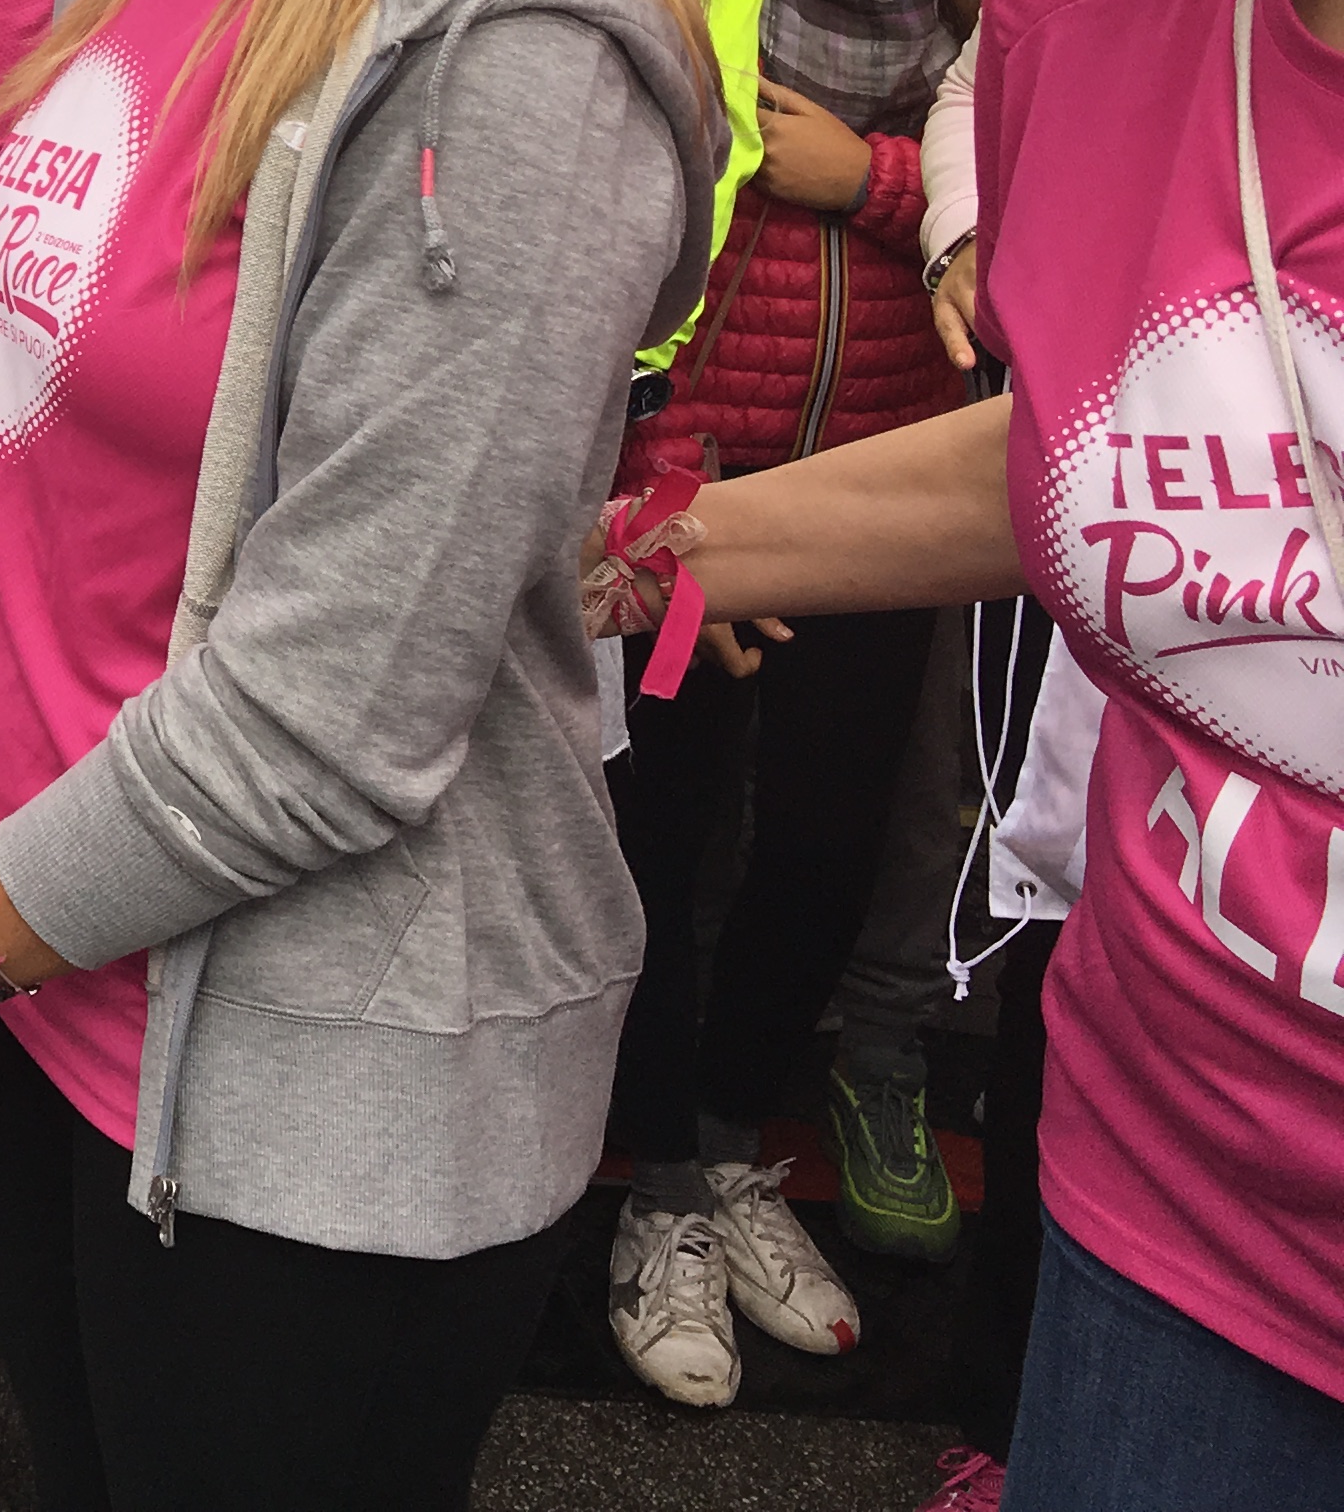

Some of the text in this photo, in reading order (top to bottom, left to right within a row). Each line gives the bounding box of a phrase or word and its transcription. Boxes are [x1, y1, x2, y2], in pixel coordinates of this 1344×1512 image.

[2, 204, 79, 315] Race
[42, 233, 84, 255] EDIZIONE
[1079, 519, 1338, 656] Pink
